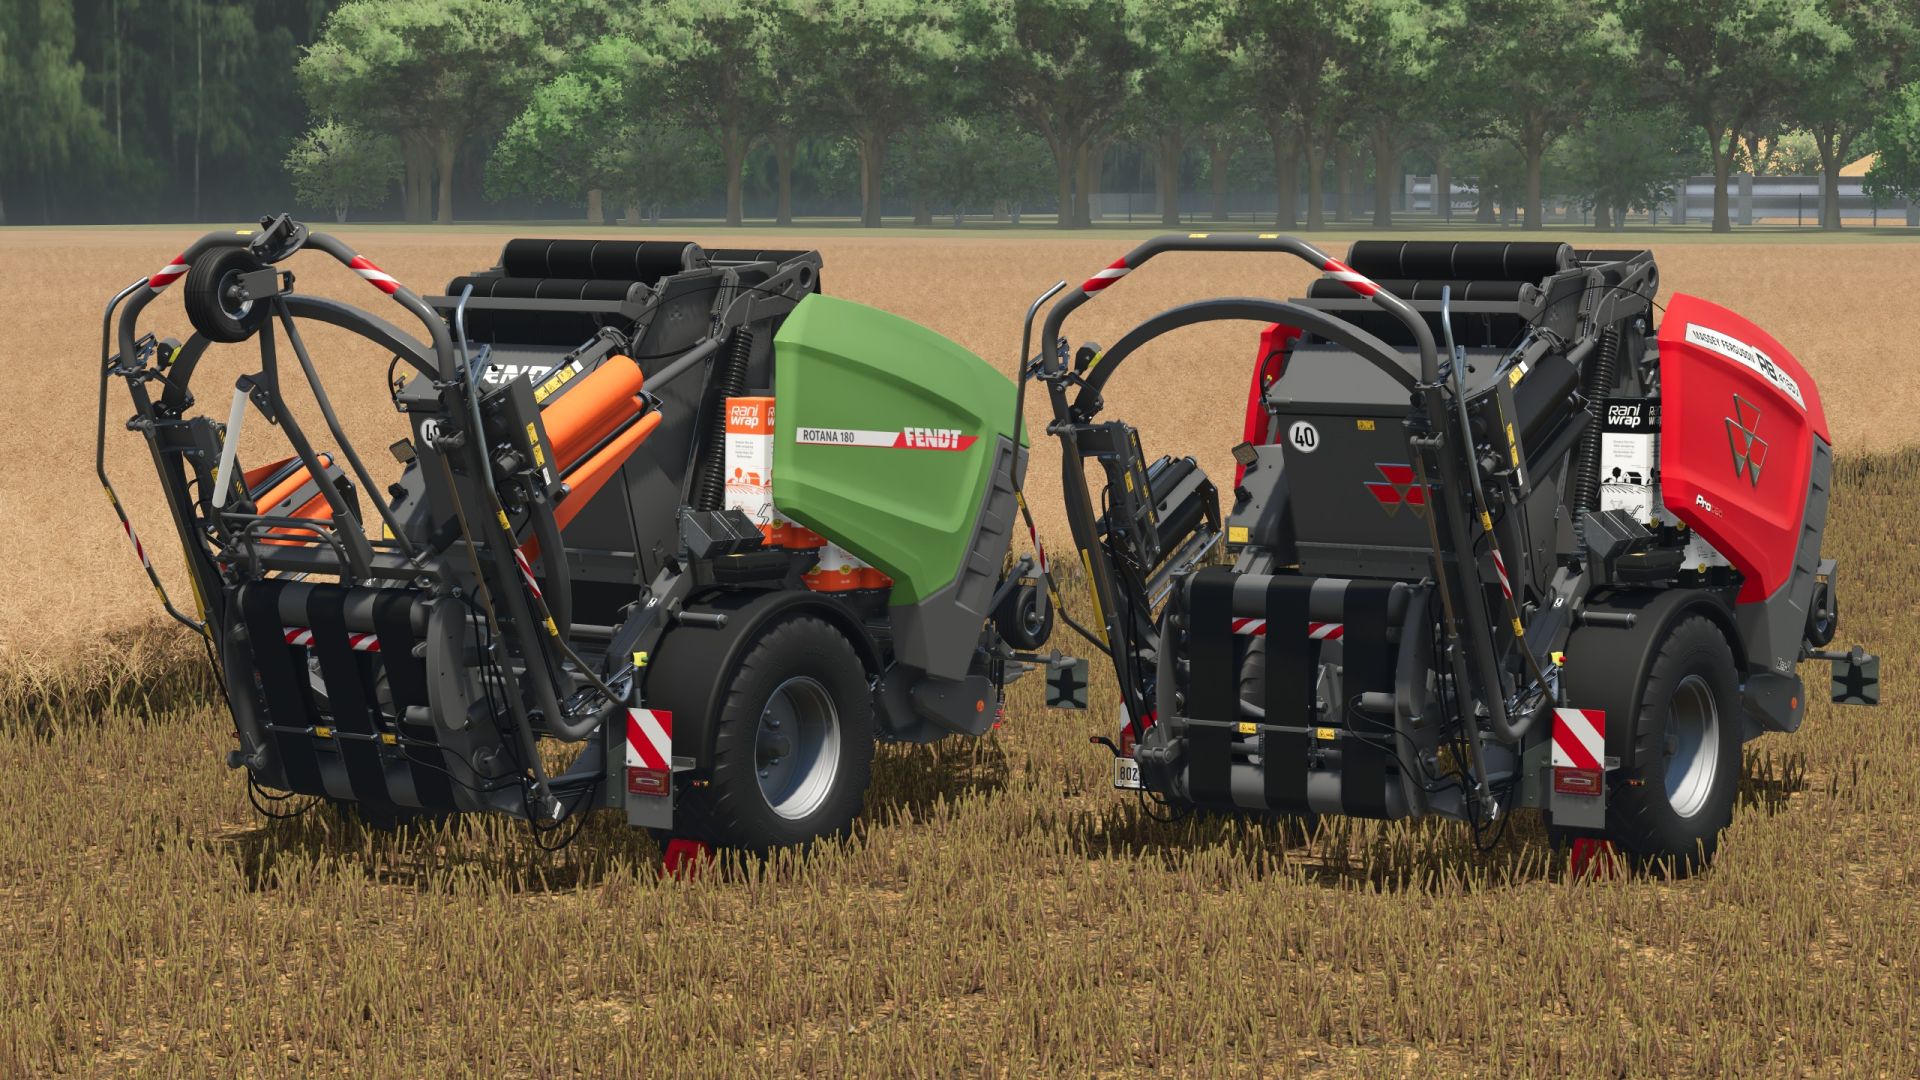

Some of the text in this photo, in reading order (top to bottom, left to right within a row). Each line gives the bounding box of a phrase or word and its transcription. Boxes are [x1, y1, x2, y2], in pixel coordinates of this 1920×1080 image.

[1692, 330, 1721, 348] MASSEY
[1721, 339, 1756, 364] FERGUSON
[731, 404, 759, 416] Rani
[1608, 403, 1642, 416] Rani
[730, 416, 759, 429] wrap
[1608, 415, 1641, 429] wrap
[803, 429, 854, 443] ROTANA 180
[903, 427, 962, 449] FENDT
[1294, 426, 1316, 448] 40
